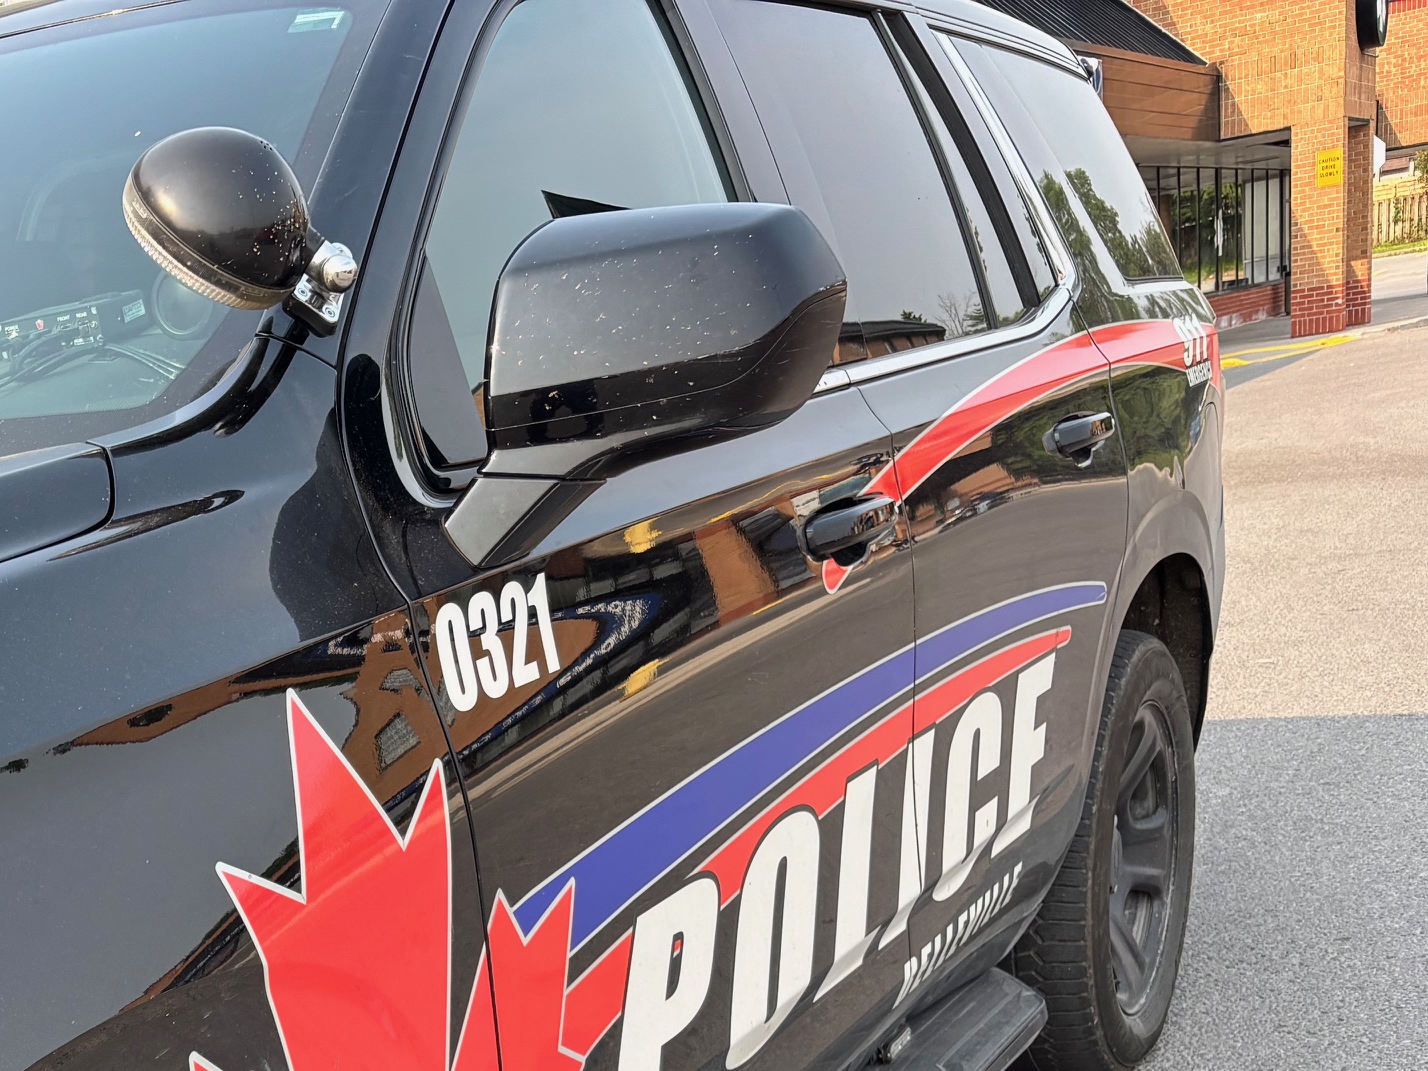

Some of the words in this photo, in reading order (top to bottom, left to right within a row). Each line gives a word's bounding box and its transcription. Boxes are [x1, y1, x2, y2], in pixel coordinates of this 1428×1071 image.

[1319, 170, 1339, 178] SLOWLY
[1173, 313, 1208, 367] 911
[435, 572, 561, 712] 0321
[892, 861, 1023, 1010] BELLEVILLE
